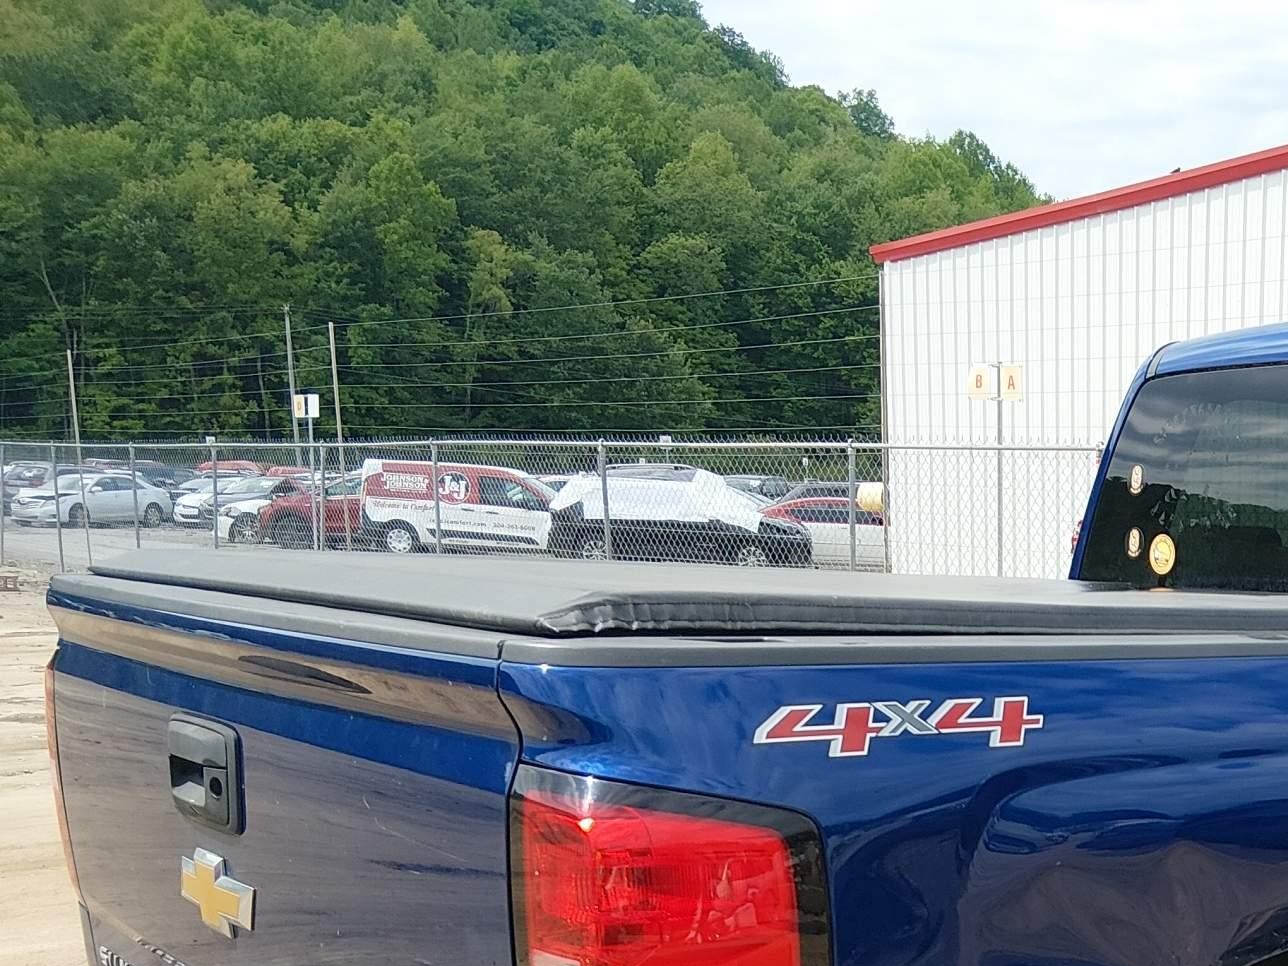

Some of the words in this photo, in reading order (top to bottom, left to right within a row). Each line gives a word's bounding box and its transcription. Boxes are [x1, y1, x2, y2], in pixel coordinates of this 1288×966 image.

[976, 374, 983, 389] B
[1007, 375, 1016, 390] A
[381, 471, 424, 484] JOHNSON
[383, 480, 428, 490] JOHNSON
[438, 475, 467, 500] J&J
